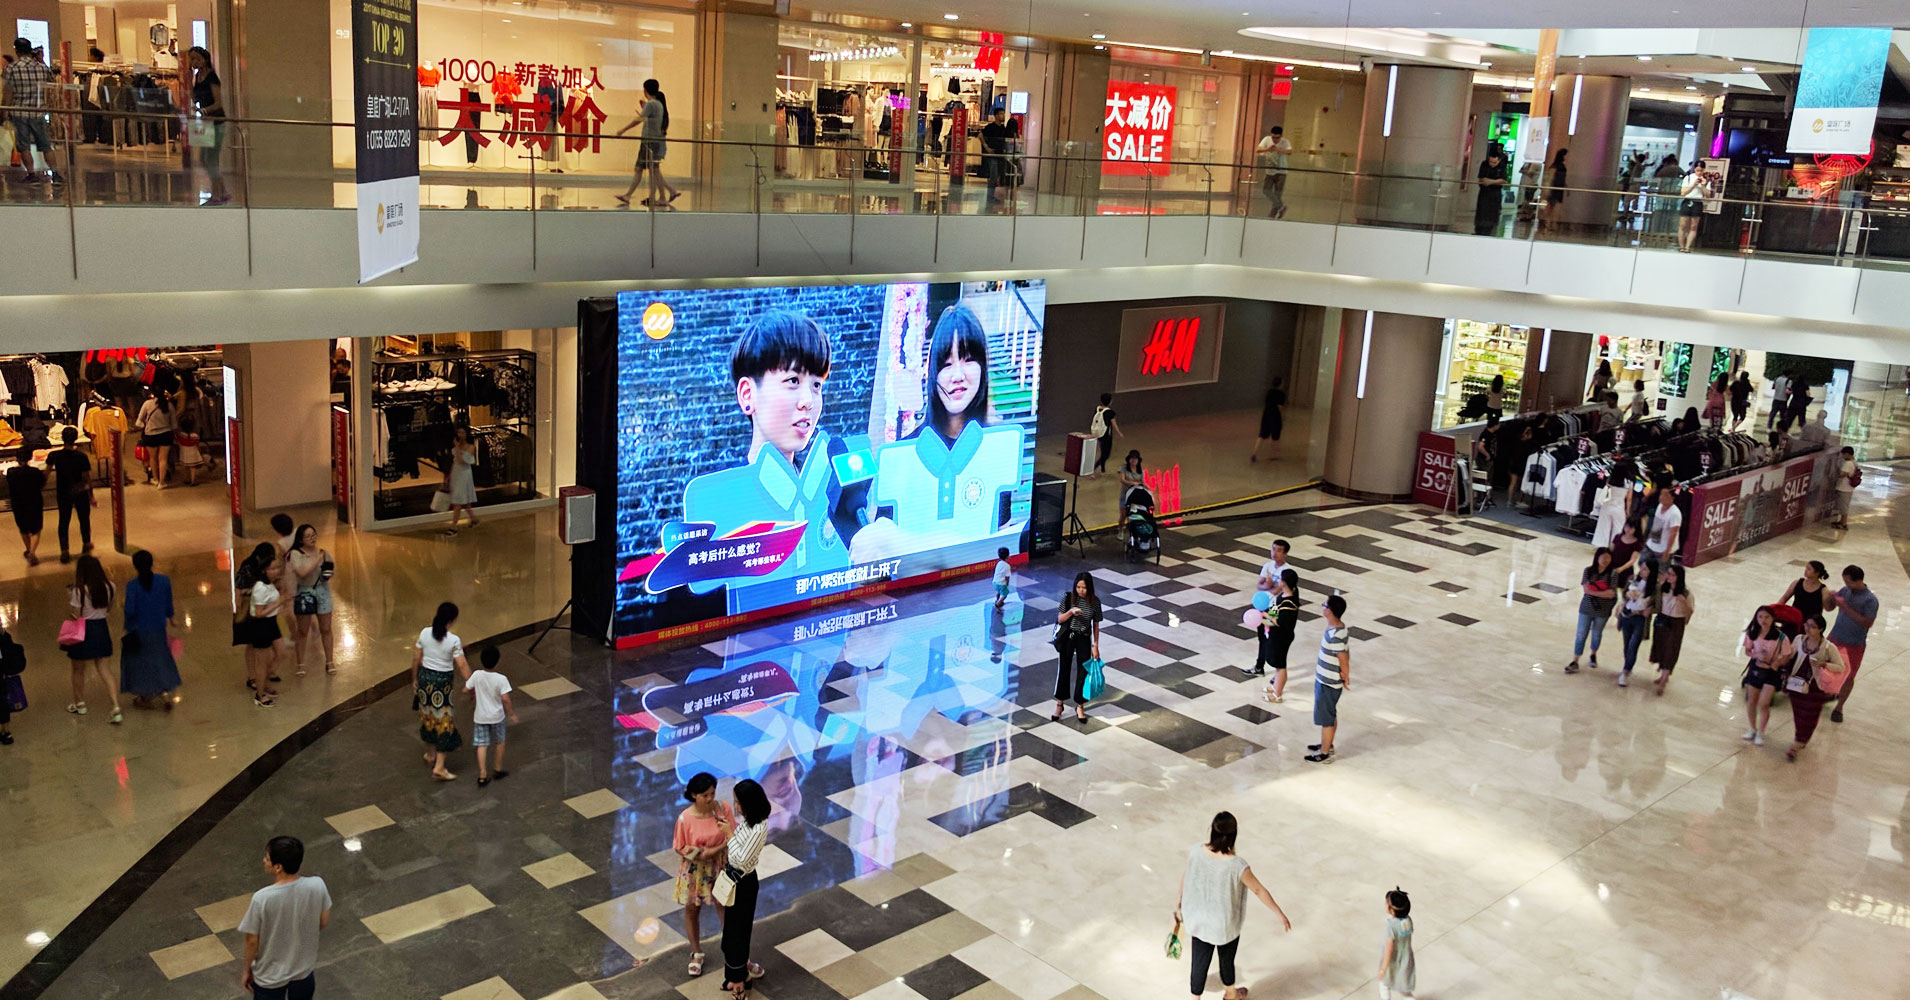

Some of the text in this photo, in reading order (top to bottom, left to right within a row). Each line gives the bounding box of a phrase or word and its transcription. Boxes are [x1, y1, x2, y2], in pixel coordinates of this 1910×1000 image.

[371, 20, 405, 57] TOP 20
[438, 57, 605, 91] 1000+新款加入
[437, 88, 608, 153] 大减价
[1104, 92, 1172, 131] 大减价
[1106, 132, 1164, 162] SALE
[1141, 317, 1201, 377] H&M
[1782, 475, 1811, 503] SALE
[1704, 499, 1737, 529] SALE
[795, 558, 901, 595] 那个紧张感就上来了
